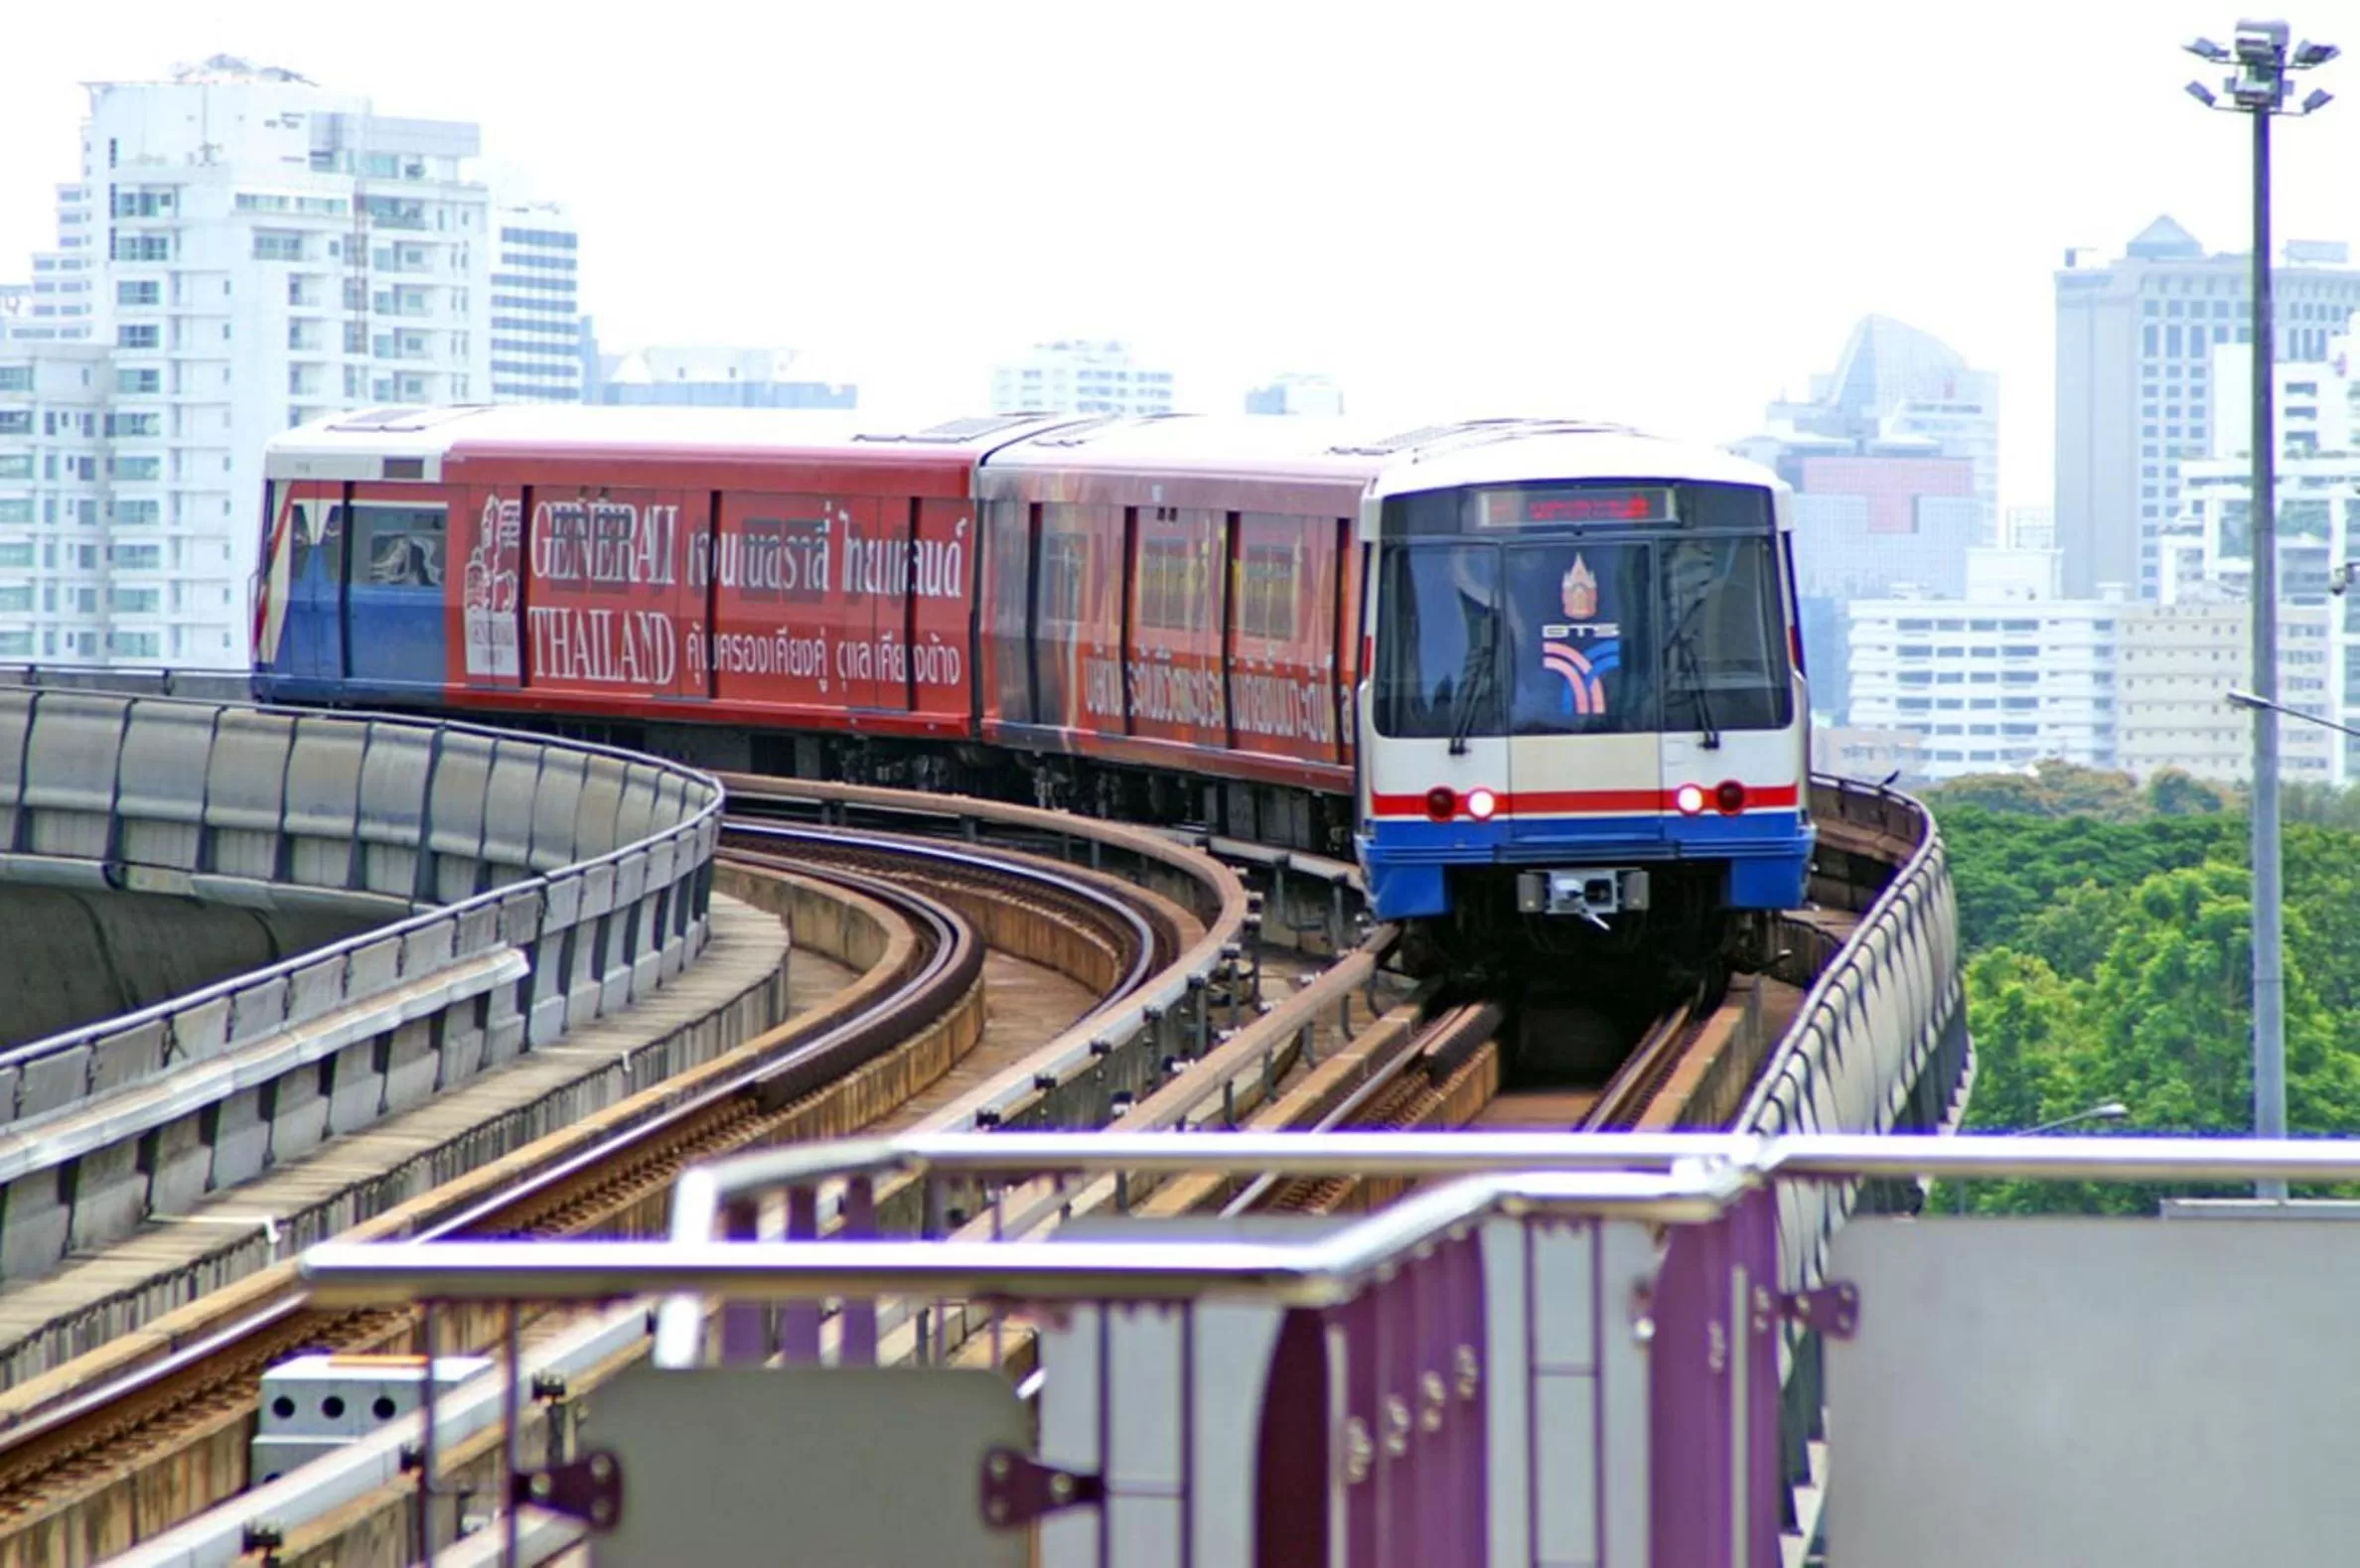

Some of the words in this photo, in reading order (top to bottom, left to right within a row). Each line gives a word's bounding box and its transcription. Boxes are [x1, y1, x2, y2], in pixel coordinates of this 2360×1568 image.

[529, 499, 679, 585] GENERALI
[527, 606, 676, 685] THAILAND
[1542, 623, 1621, 639] BTS
